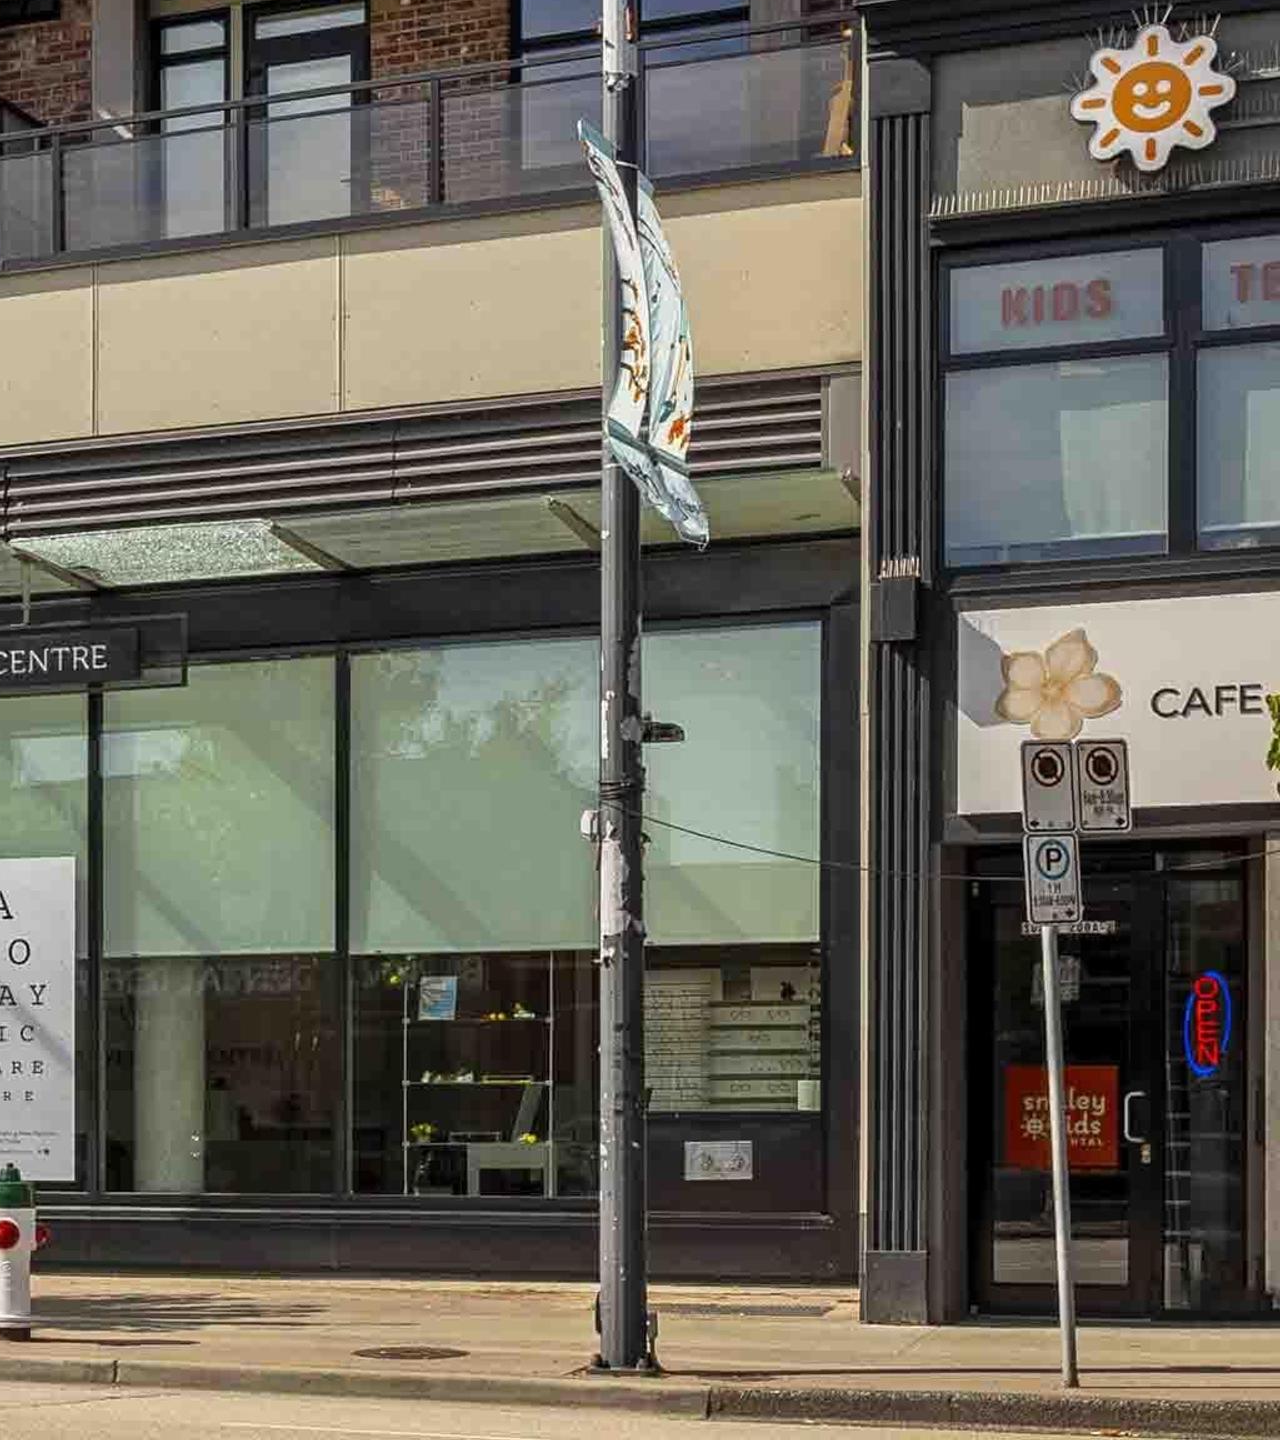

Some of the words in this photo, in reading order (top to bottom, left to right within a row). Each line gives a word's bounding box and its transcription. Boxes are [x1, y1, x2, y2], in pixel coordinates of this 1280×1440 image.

[1001, 279, 1112, 328] KIDS
[1151, 683, 1263, 718] CAFE
[1194, 977, 1218, 1065] OPEN
